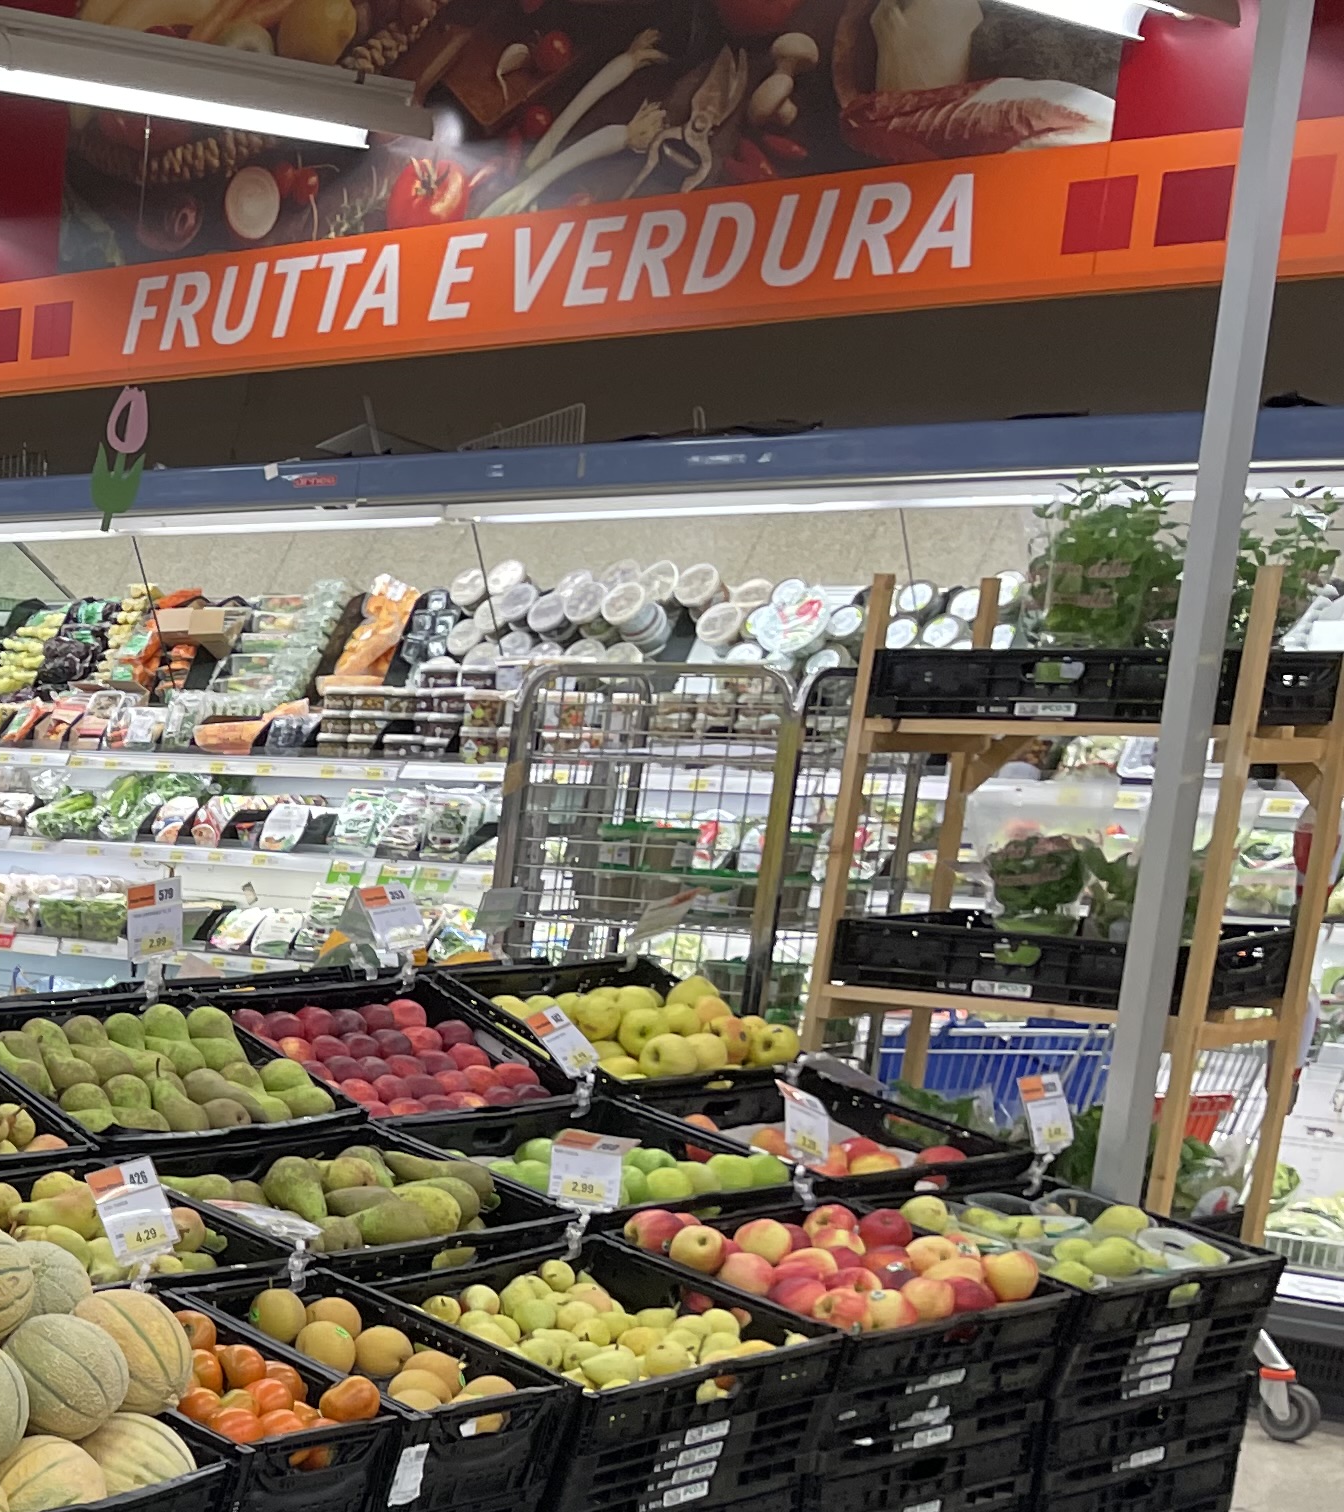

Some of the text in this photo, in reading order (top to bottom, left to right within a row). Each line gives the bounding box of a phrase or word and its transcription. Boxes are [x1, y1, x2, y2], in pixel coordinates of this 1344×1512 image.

[123, 172, 975, 355] FRUTTA E VERDURA
[571, 1180, 595, 1193] 2,99
[135, 1227, 157, 1243] 4,29
